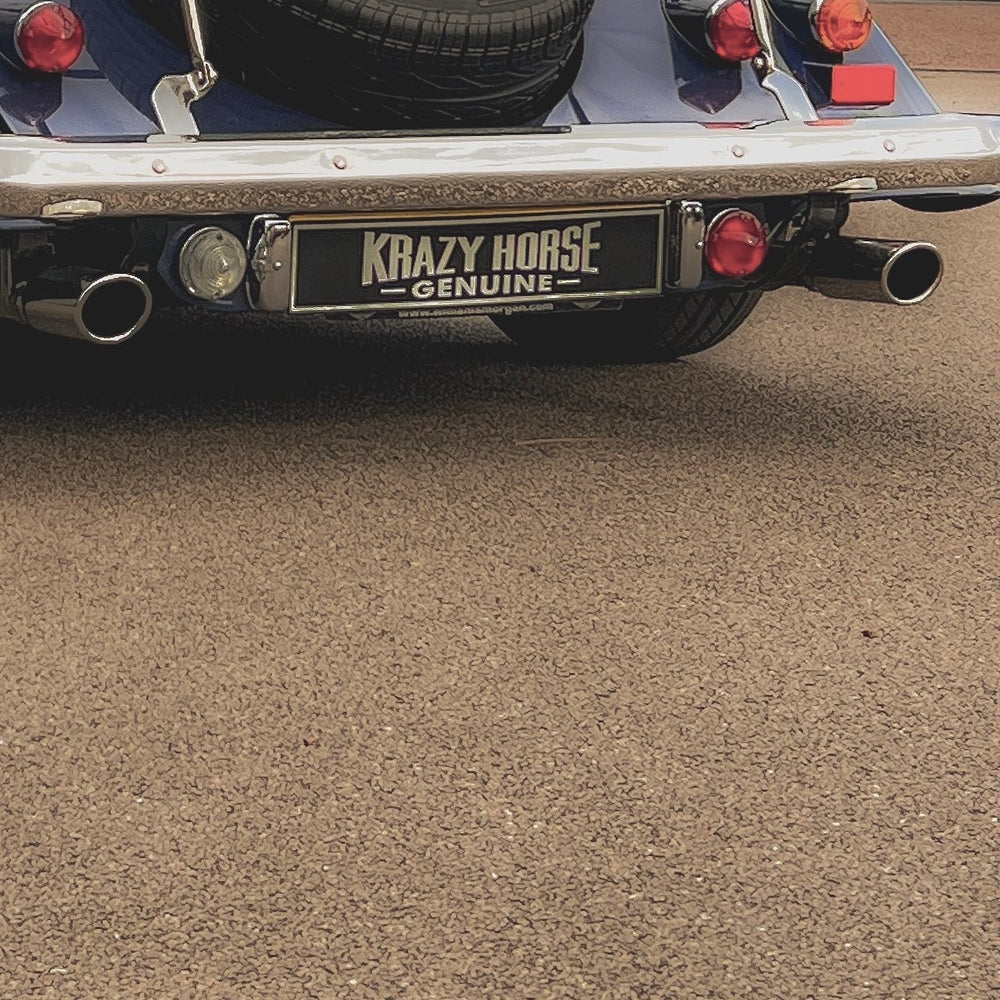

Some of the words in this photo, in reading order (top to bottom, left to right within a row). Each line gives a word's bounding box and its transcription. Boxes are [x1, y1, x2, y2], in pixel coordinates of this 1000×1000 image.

[361, 230, 484, 287] KRAZY
[491, 221, 602, 274] HORSE
[411, 274, 553, 300] GENUINE
